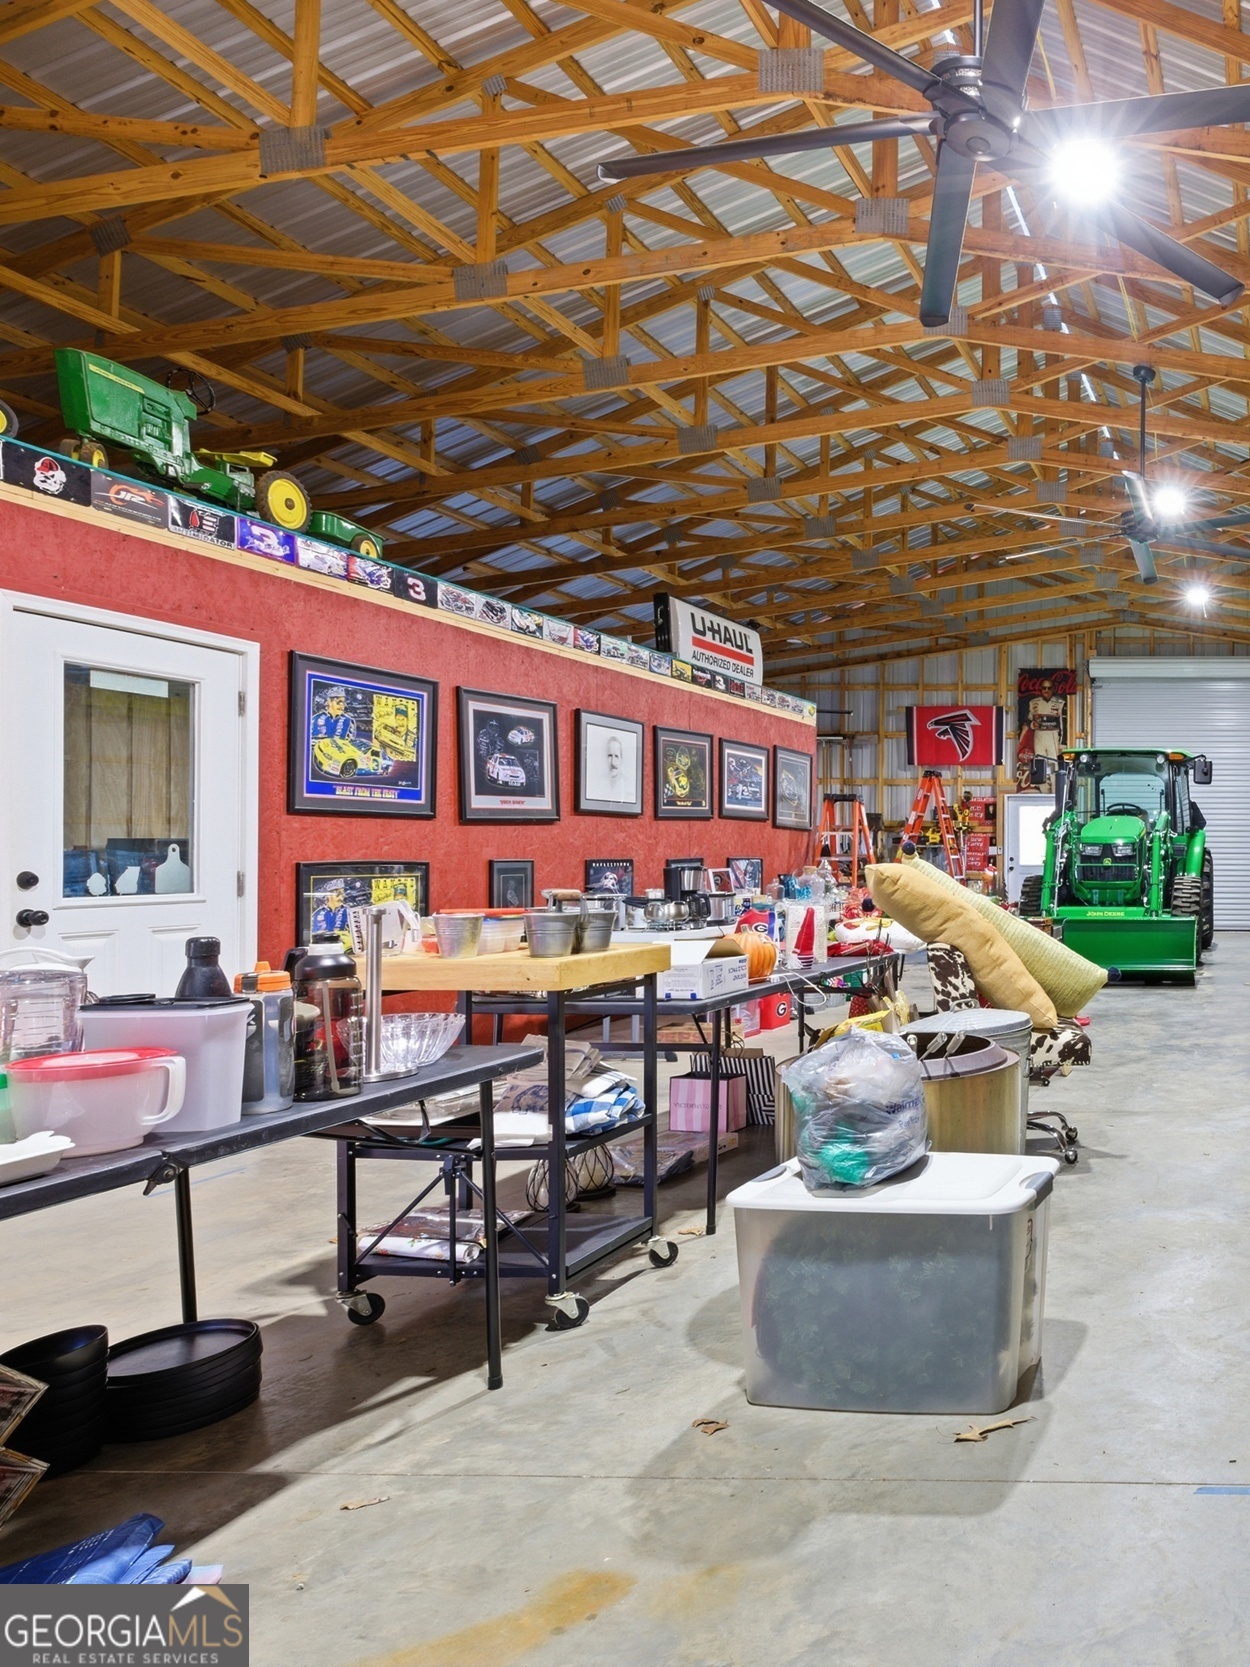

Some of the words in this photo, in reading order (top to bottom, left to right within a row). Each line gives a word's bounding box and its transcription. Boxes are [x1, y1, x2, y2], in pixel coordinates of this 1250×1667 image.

[407, 577, 426, 600] 3
[690, 612, 753, 655] U-HAUL
[691, 650, 731, 671] AUTHORIZED
[731, 662, 754, 678] DEALER
[776, 1002, 787, 1017] G
